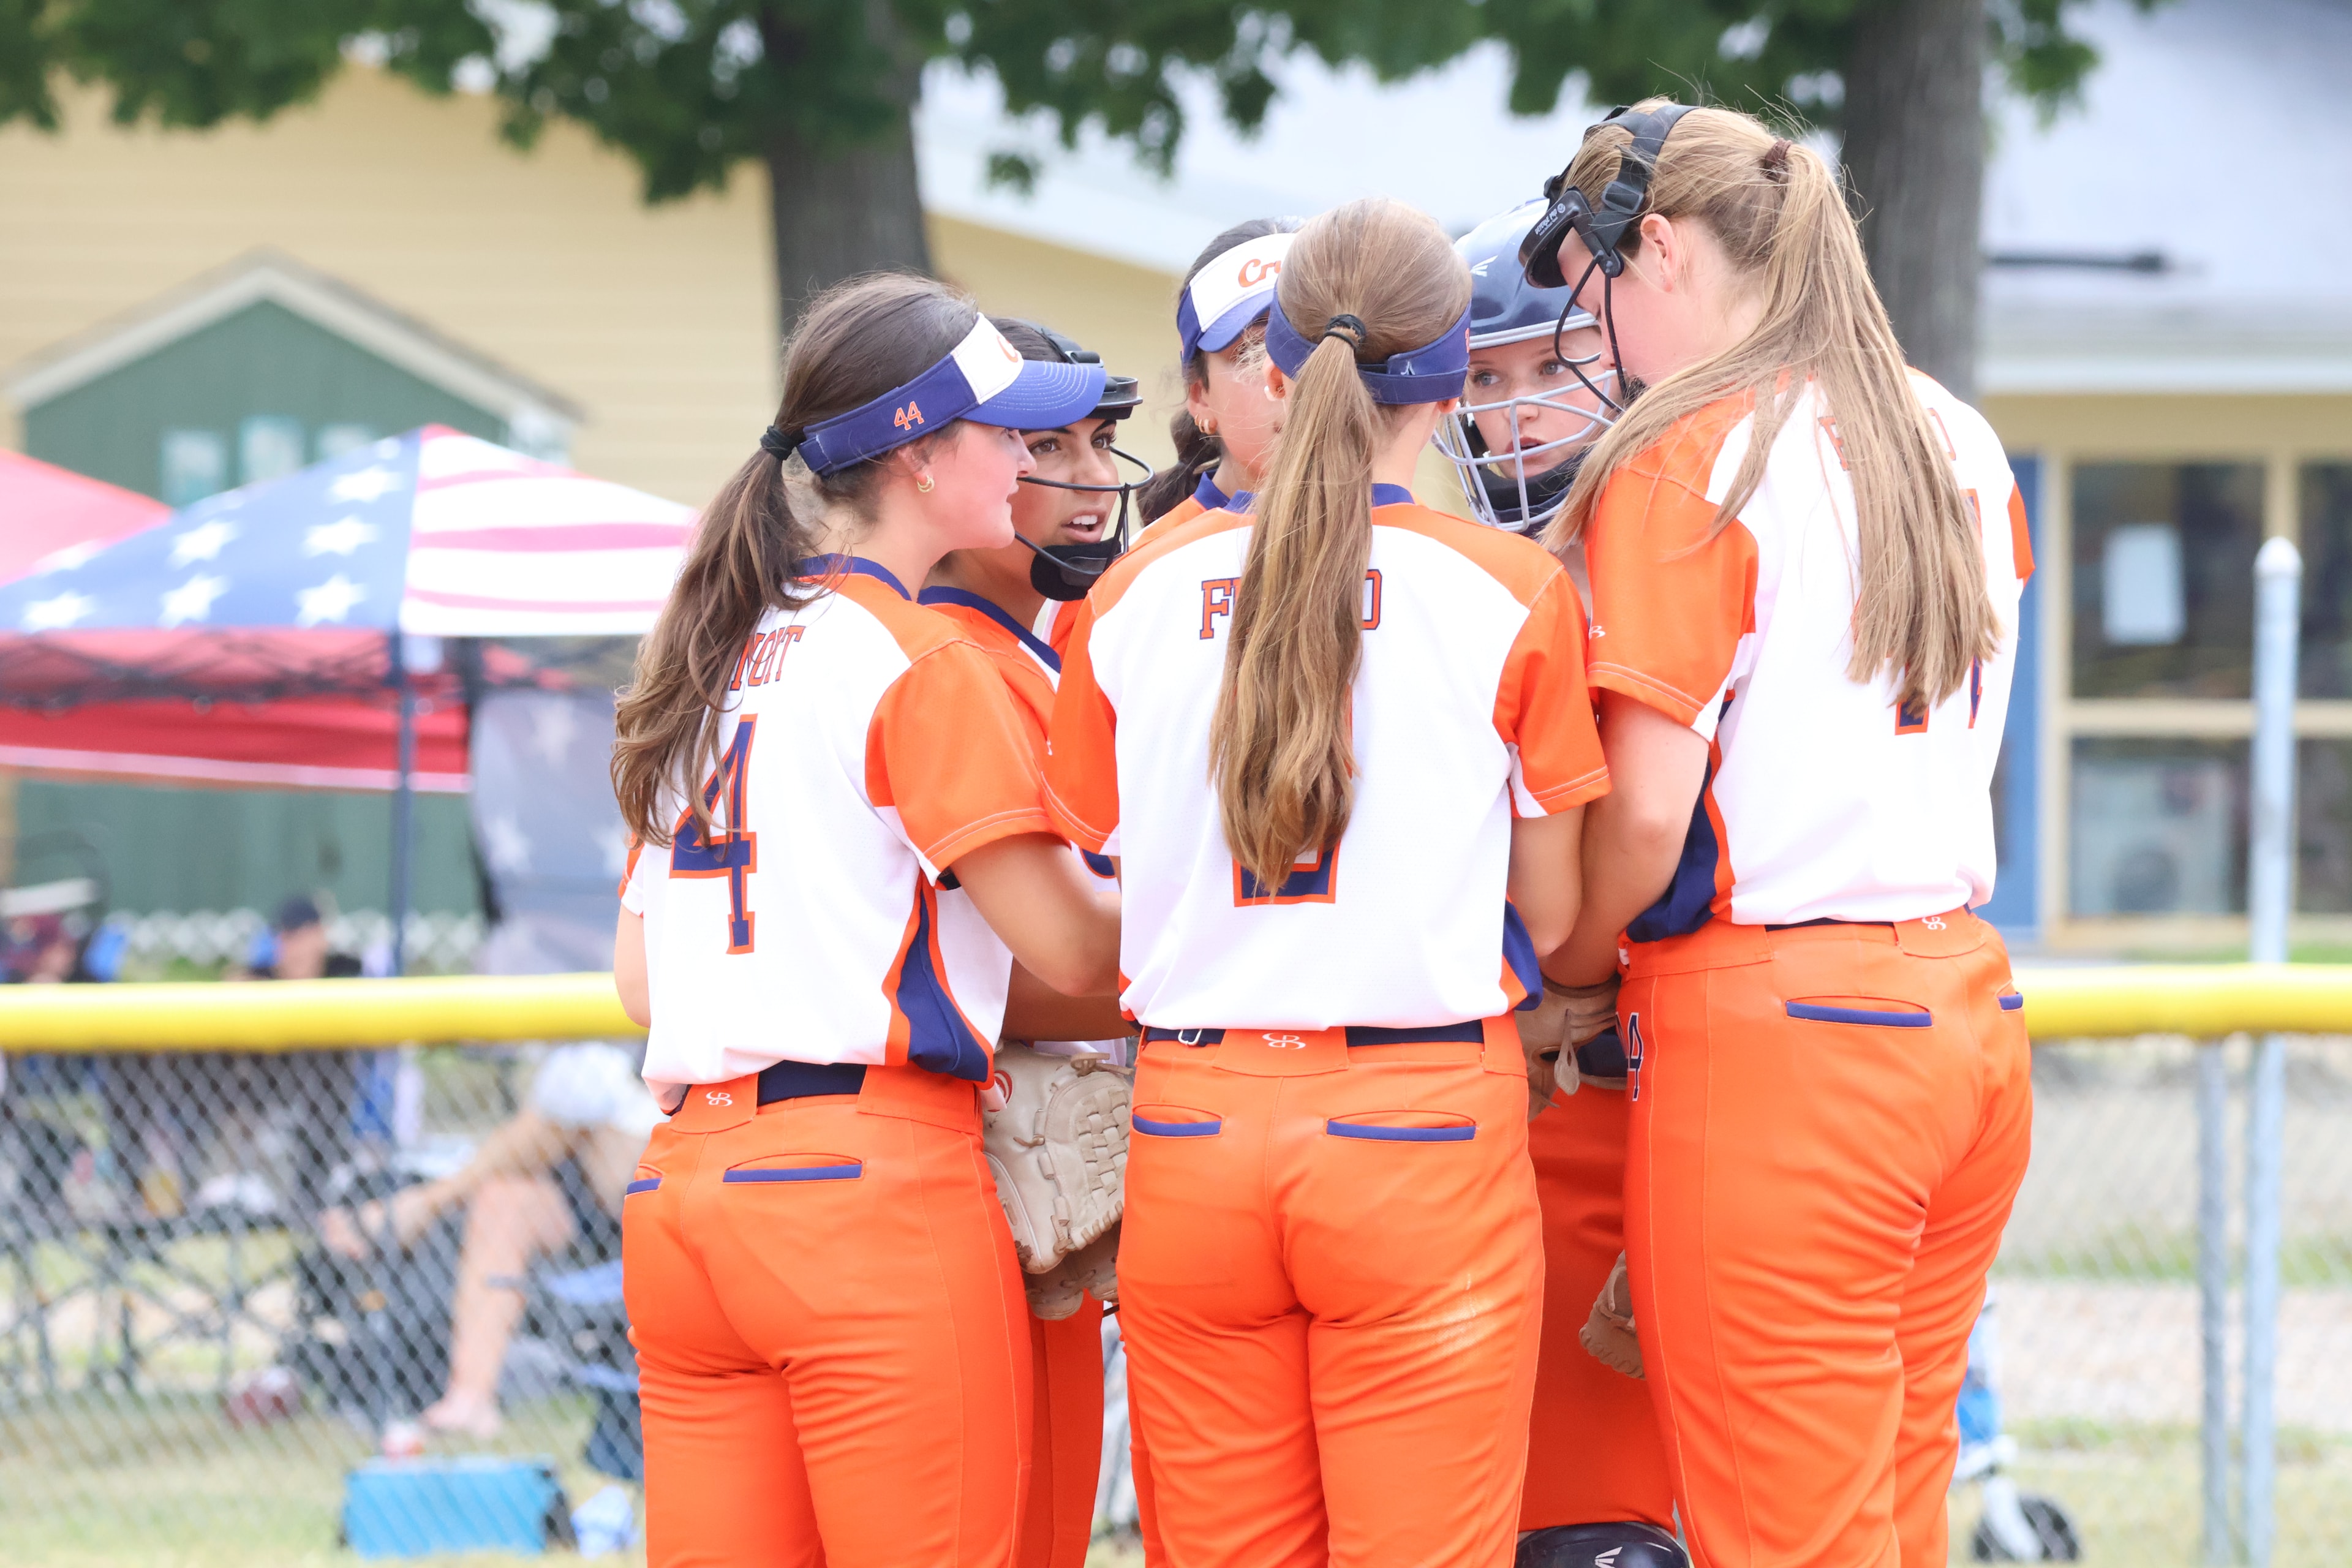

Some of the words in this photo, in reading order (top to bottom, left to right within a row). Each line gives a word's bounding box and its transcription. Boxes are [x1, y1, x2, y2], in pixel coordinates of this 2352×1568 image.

[1238, 258, 1281, 288] Cr
[894, 401, 924, 431] 44
[669, 713, 757, 954] 4
[1615, 1012, 1644, 1101] 4
